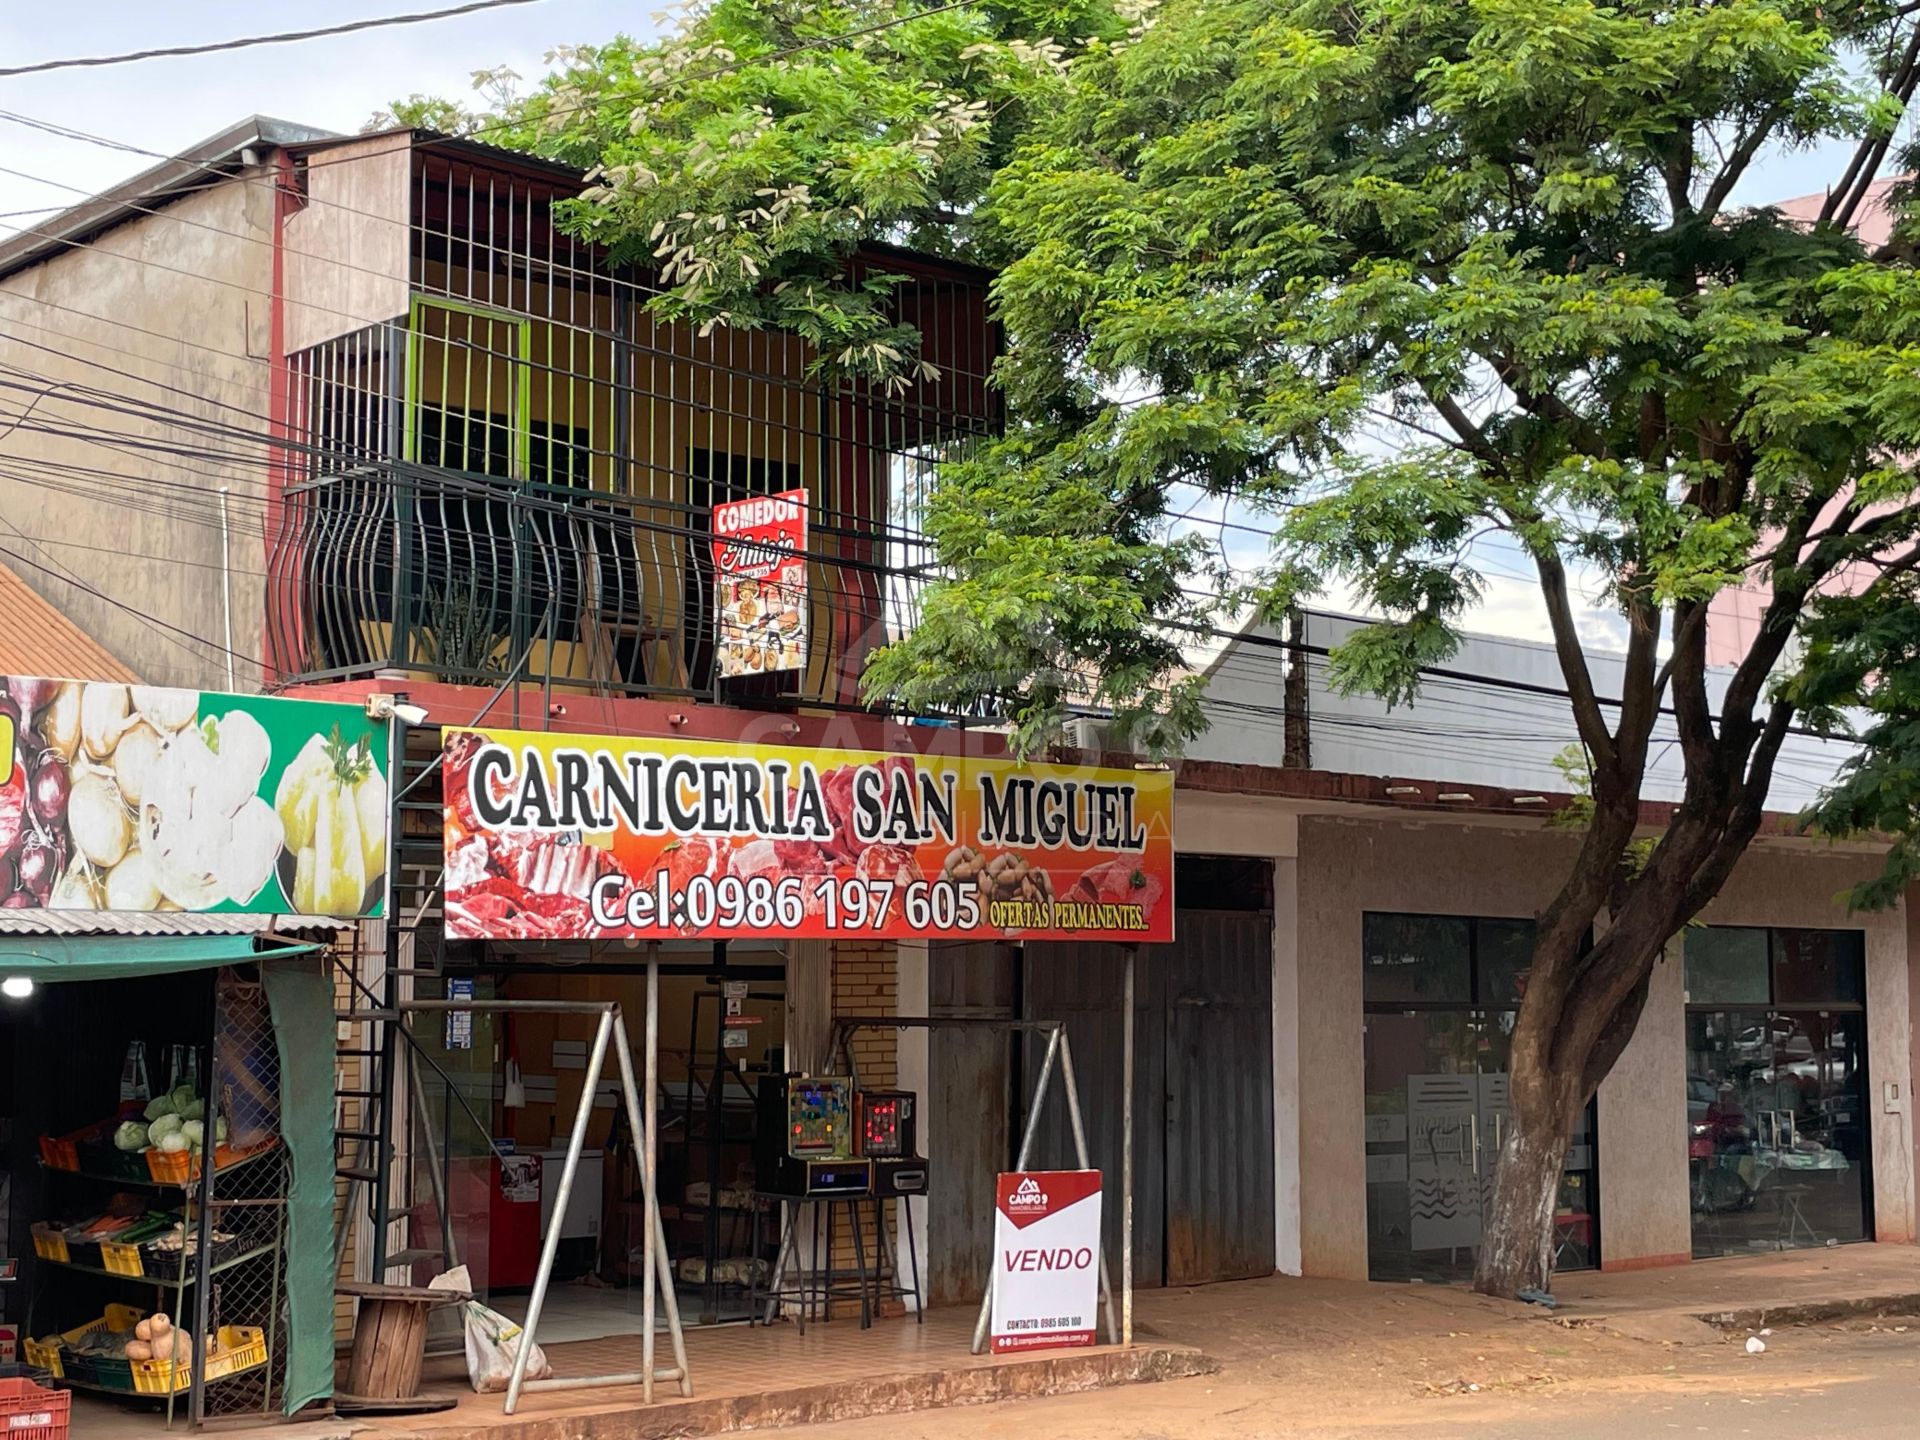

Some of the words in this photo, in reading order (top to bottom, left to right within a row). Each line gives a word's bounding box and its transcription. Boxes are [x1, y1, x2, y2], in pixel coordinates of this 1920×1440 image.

[718, 495, 799, 533] COMEDOR
[471, 747, 832, 838] CARNICERIA
[855, 767, 957, 844] SAN
[980, 773, 1147, 851] MIGUEL
[590, 869, 804, 931] Cel:0986
[814, 878, 895, 931] 197
[905, 880, 981, 930] 605
[989, 900, 1050, 929] OFERTAS
[1009, 1194, 1041, 1205] CAMPO
[1041, 1193, 1048, 1205] 9
[1005, 1247, 1092, 1271] VENDO
